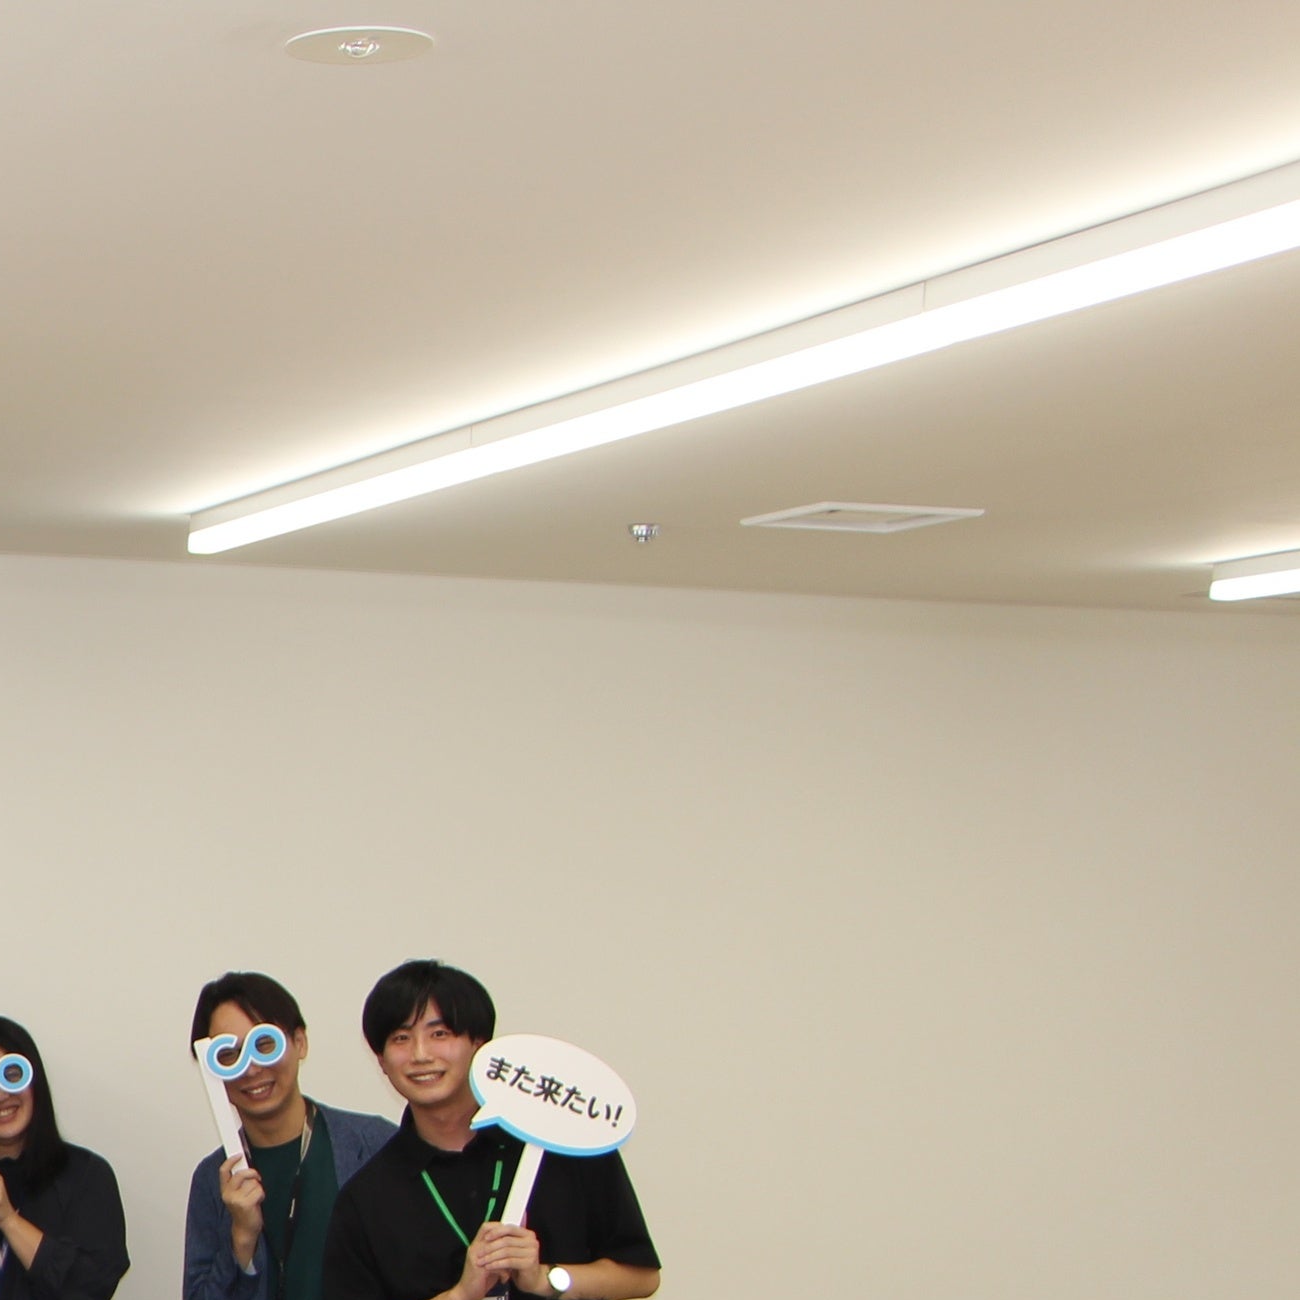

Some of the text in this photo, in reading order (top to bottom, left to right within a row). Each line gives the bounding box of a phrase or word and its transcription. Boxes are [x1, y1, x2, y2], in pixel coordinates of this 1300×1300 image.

[486, 1057, 623, 1127] また来たい!
